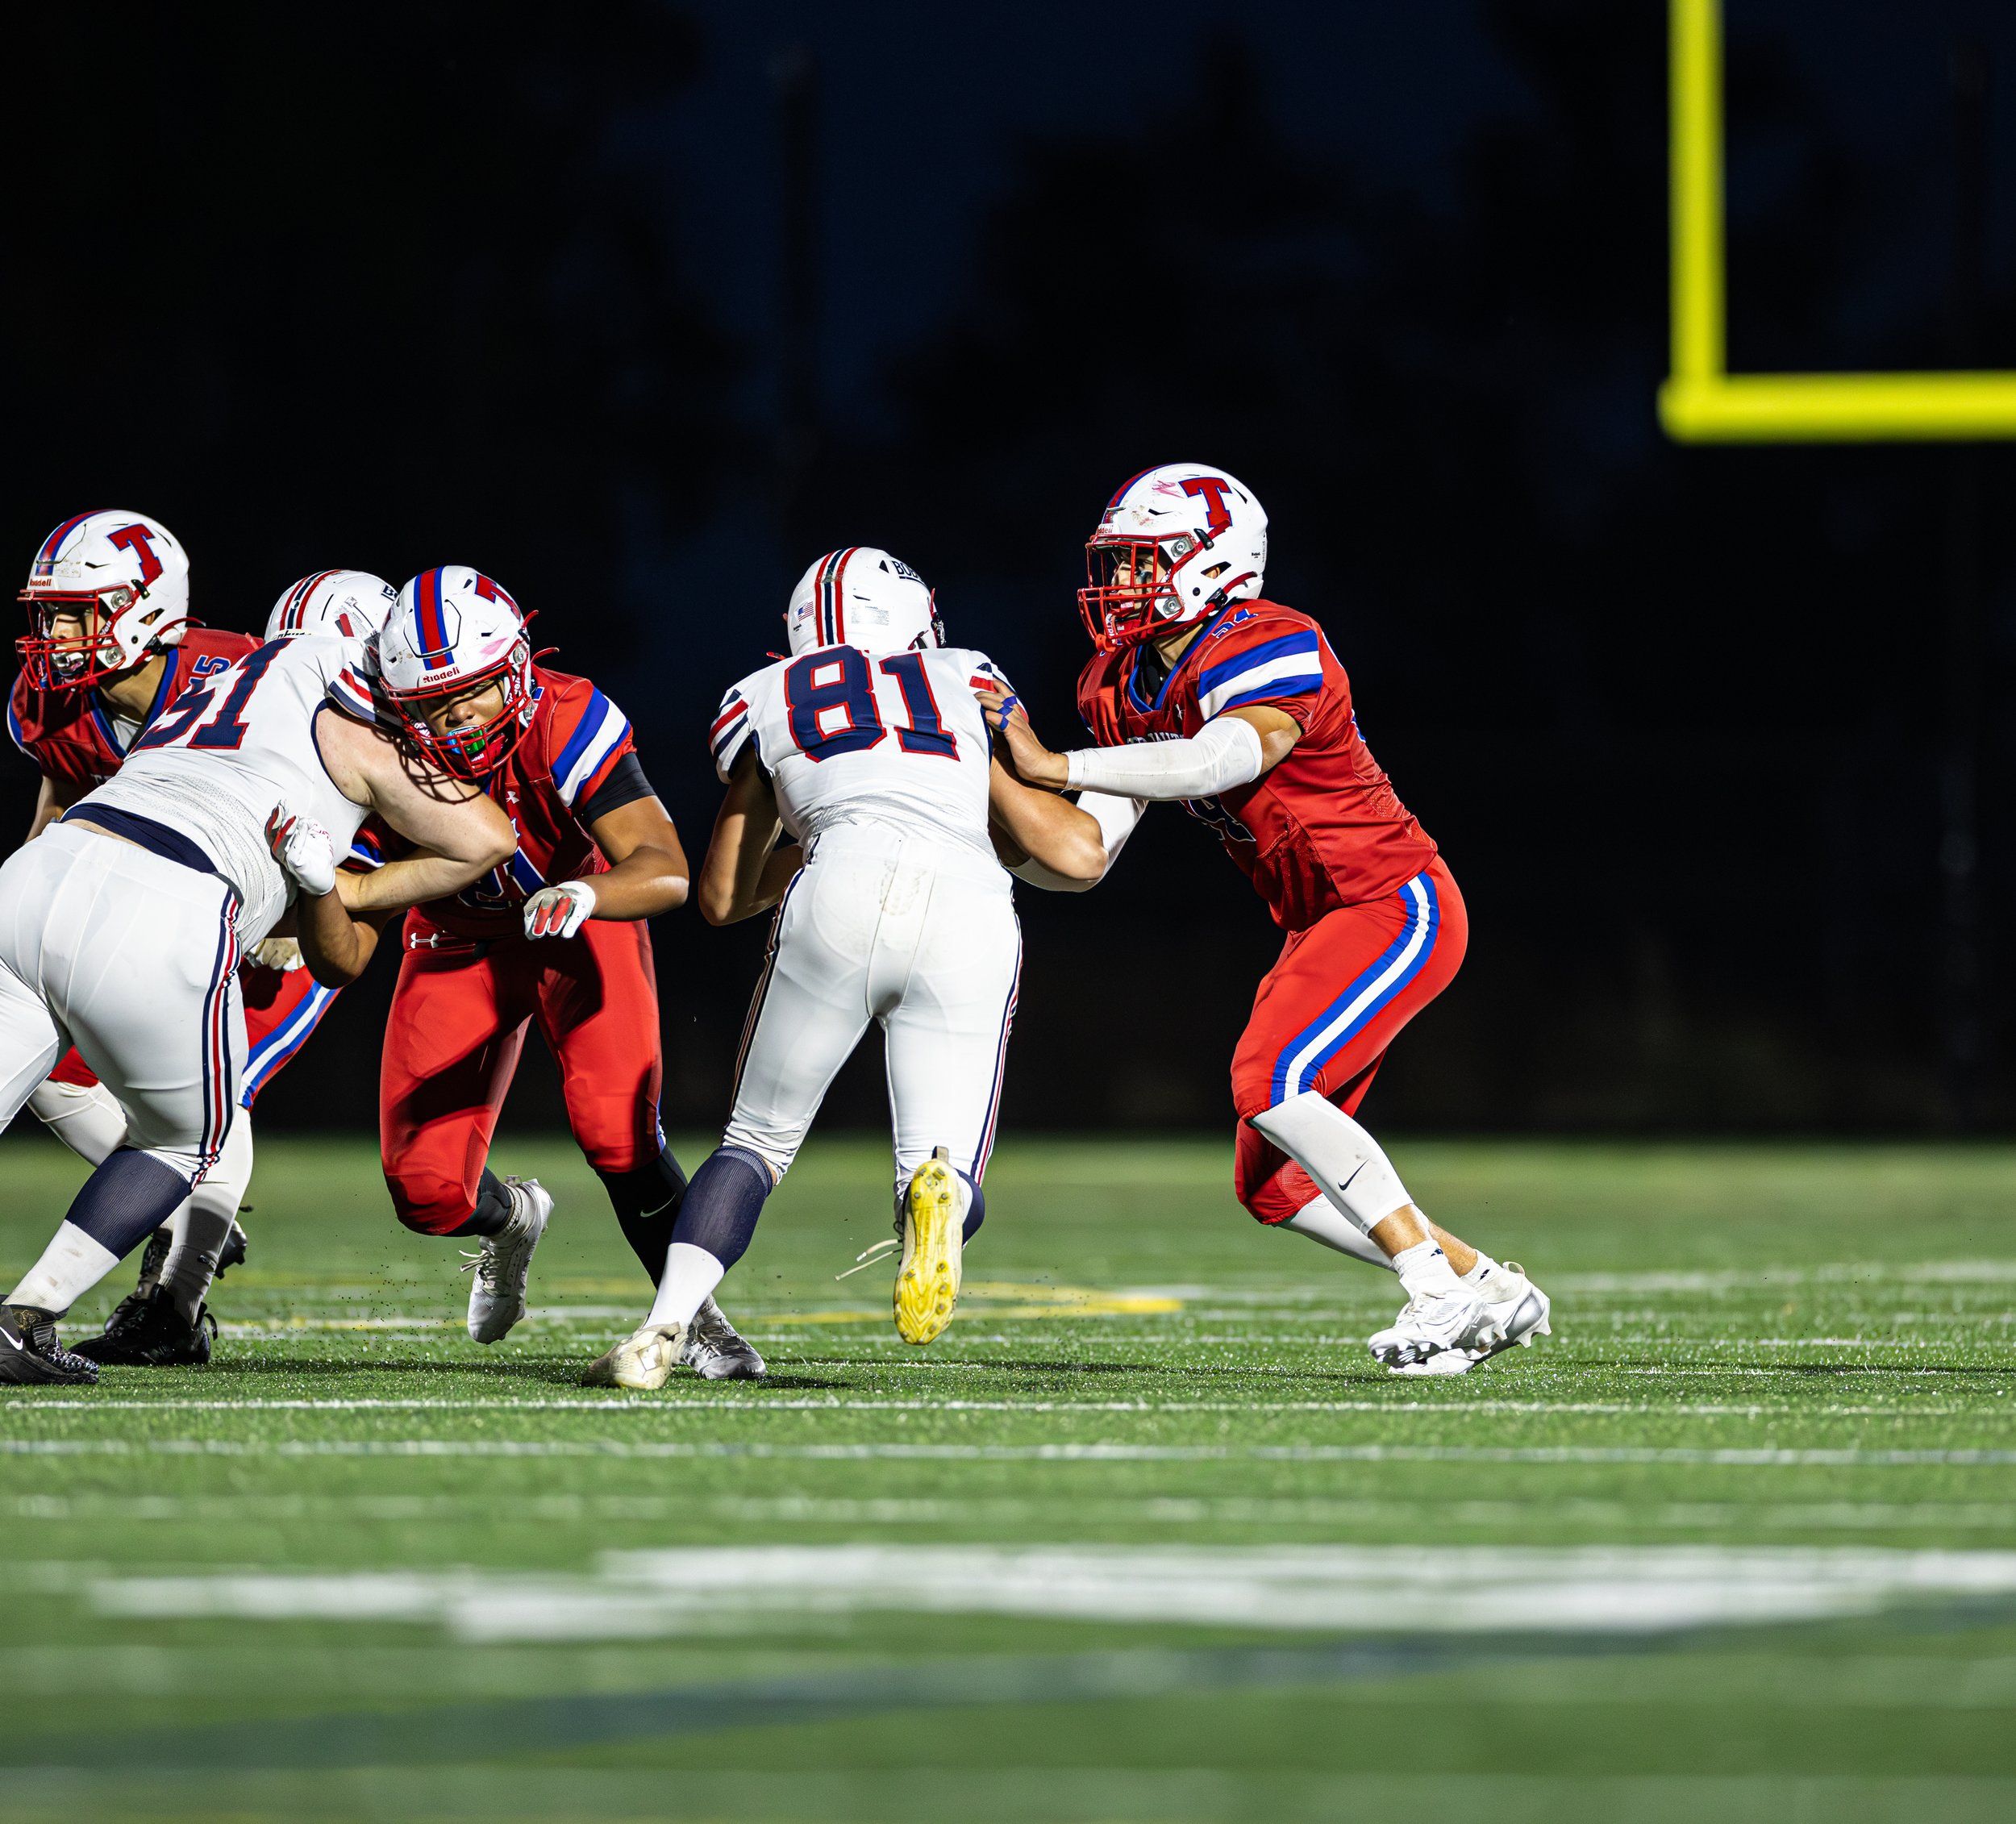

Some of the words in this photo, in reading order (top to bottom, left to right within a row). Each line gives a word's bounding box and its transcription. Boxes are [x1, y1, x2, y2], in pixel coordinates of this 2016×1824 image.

[1177, 477, 1233, 528] T
[106, 523, 164, 580] T
[474, 573, 521, 621] T
[129, 637, 296, 756] 51
[423, 666, 460, 683] Riddell
[784, 645, 960, 763] 81
